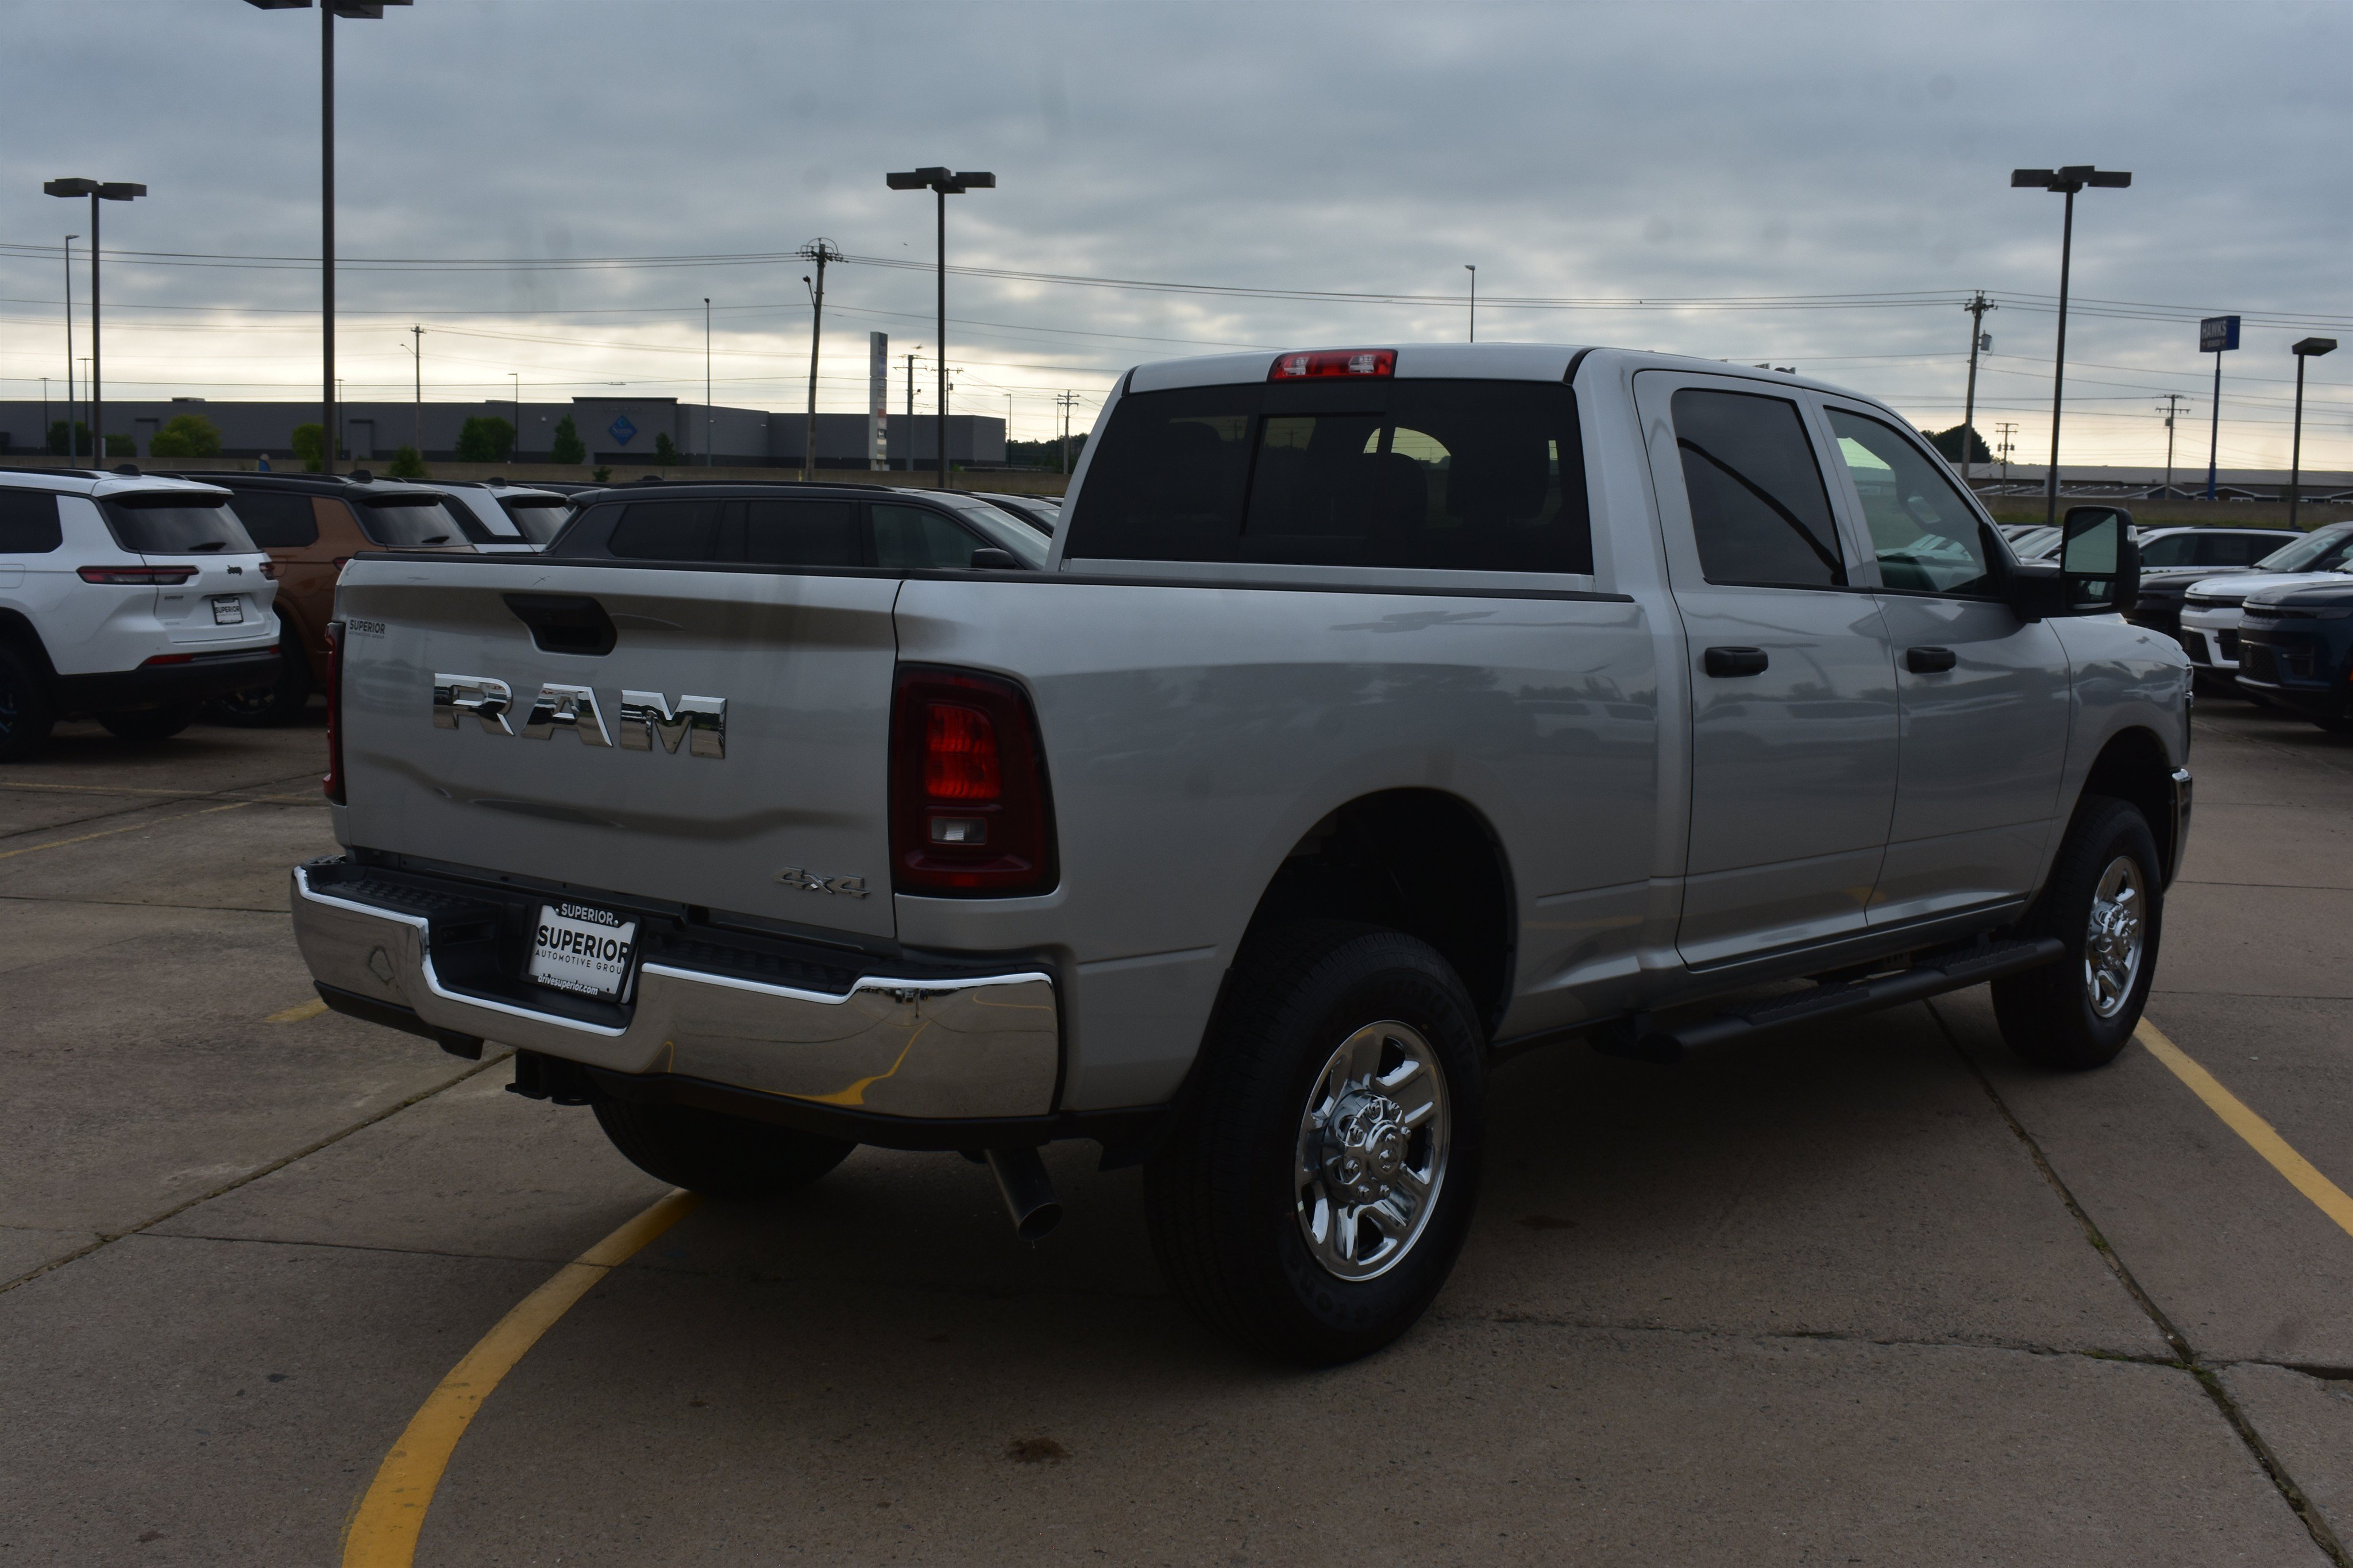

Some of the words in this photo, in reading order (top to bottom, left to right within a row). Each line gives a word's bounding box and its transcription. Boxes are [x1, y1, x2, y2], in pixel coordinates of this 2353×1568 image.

[2201, 320, 2227, 339] HAWKS
[349, 620, 385, 634] SUPERIOR
[433, 673, 728, 760] RAM
[561, 903, 613, 925] SUPERIOR
[537, 925, 630, 963] SUPERIOR
[535, 949, 591, 968] AUTOMOTIVE
[596, 962, 622, 975] GROU
[538, 973, 598, 996] drivesuperior.com
